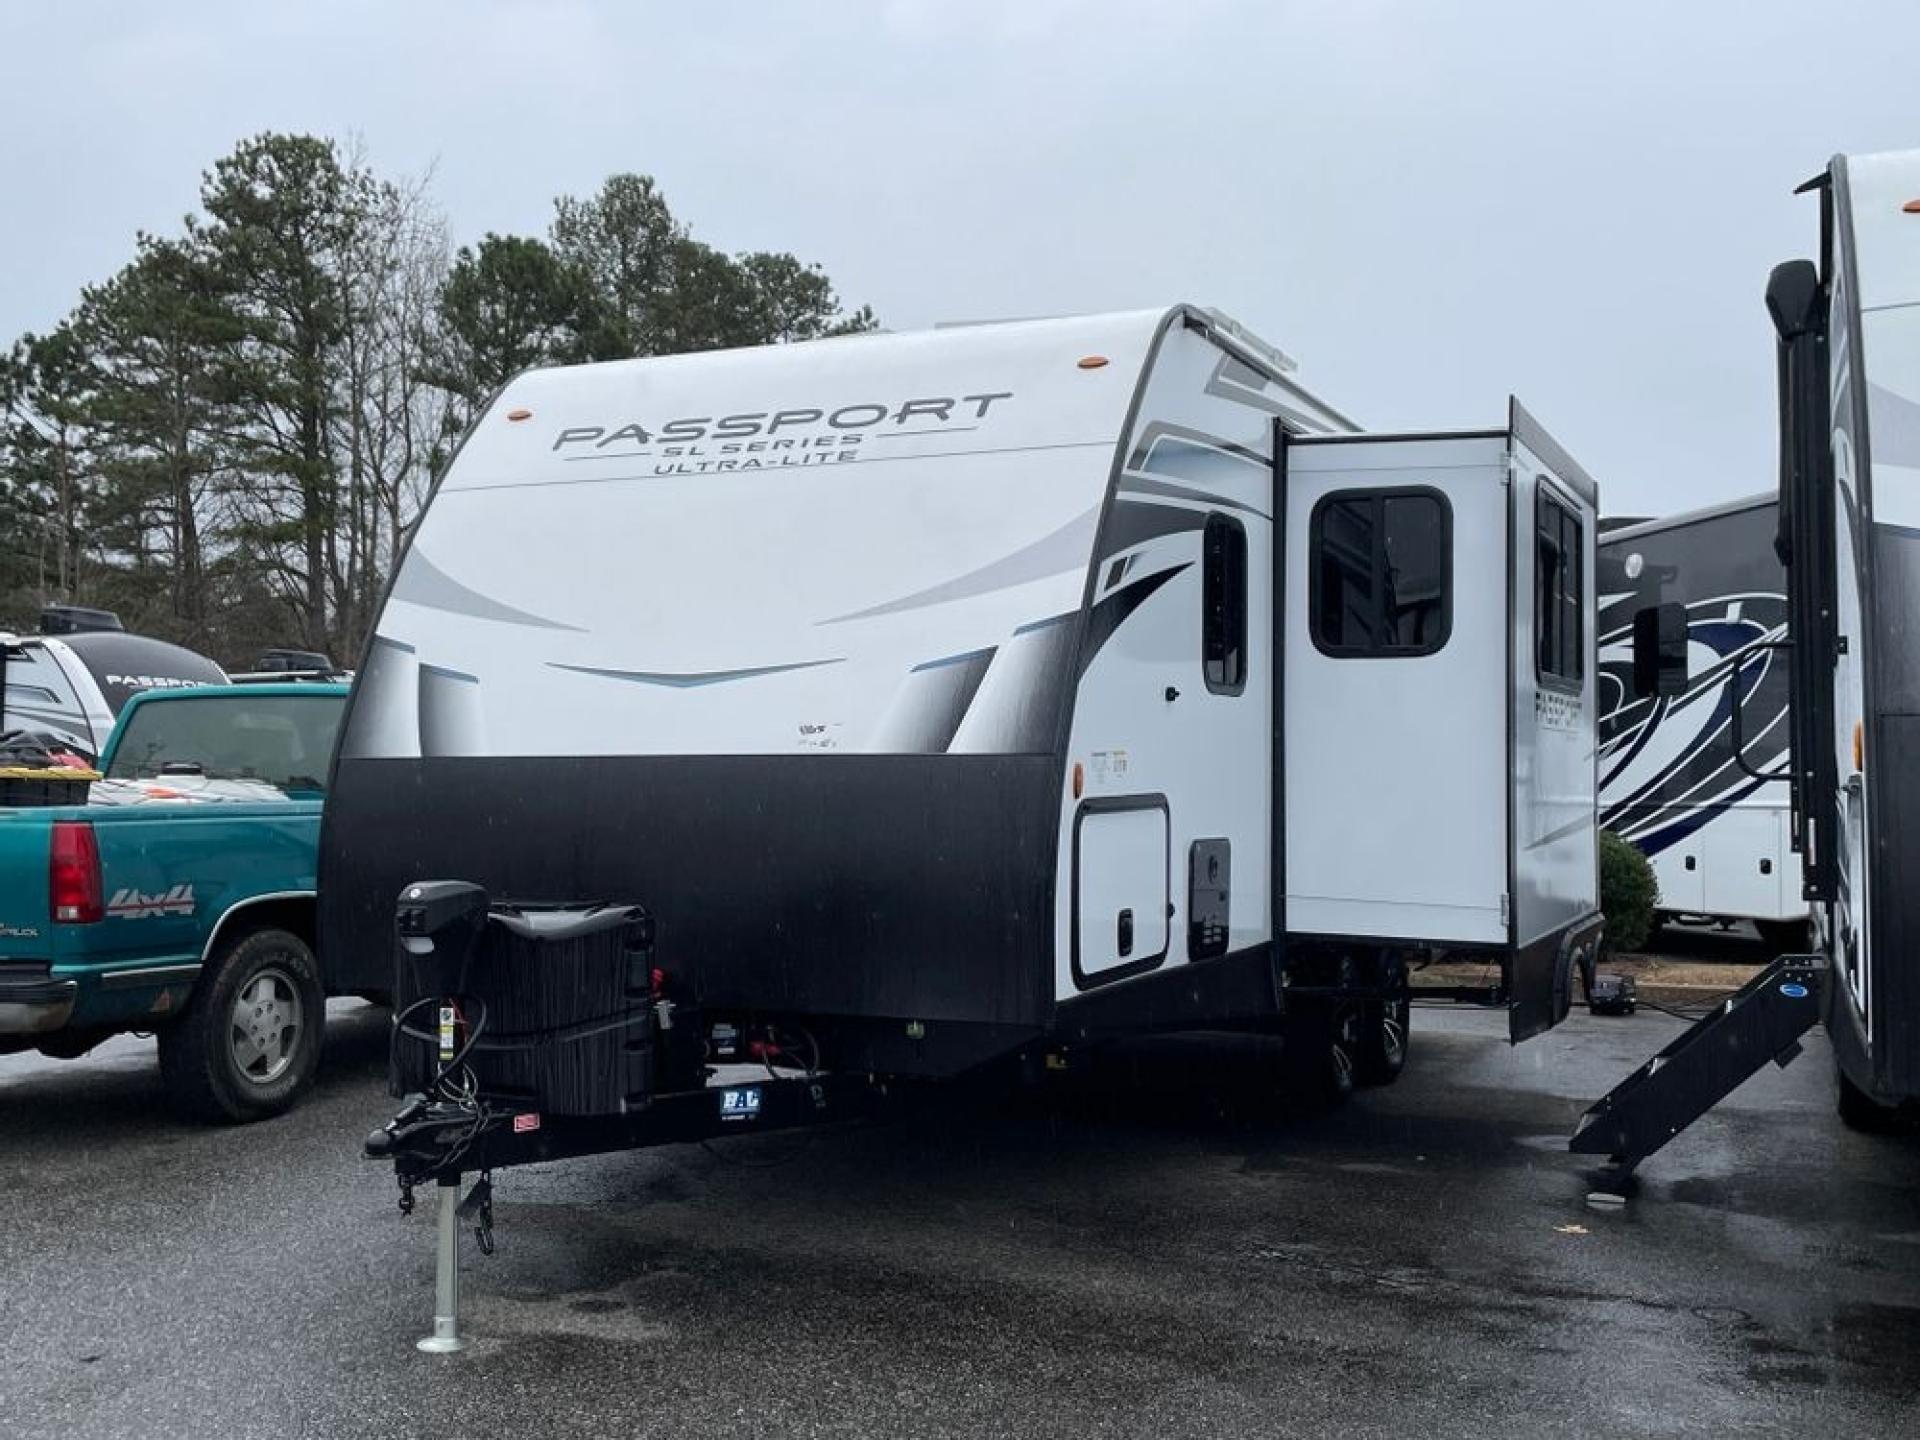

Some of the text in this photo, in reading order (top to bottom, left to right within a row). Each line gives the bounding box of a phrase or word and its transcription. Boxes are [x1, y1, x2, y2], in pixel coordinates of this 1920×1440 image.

[552, 391, 1014, 452] PASSPORT
[661, 433, 864, 458] SL SERIES
[654, 449, 858, 475] ULTRA-LITE
